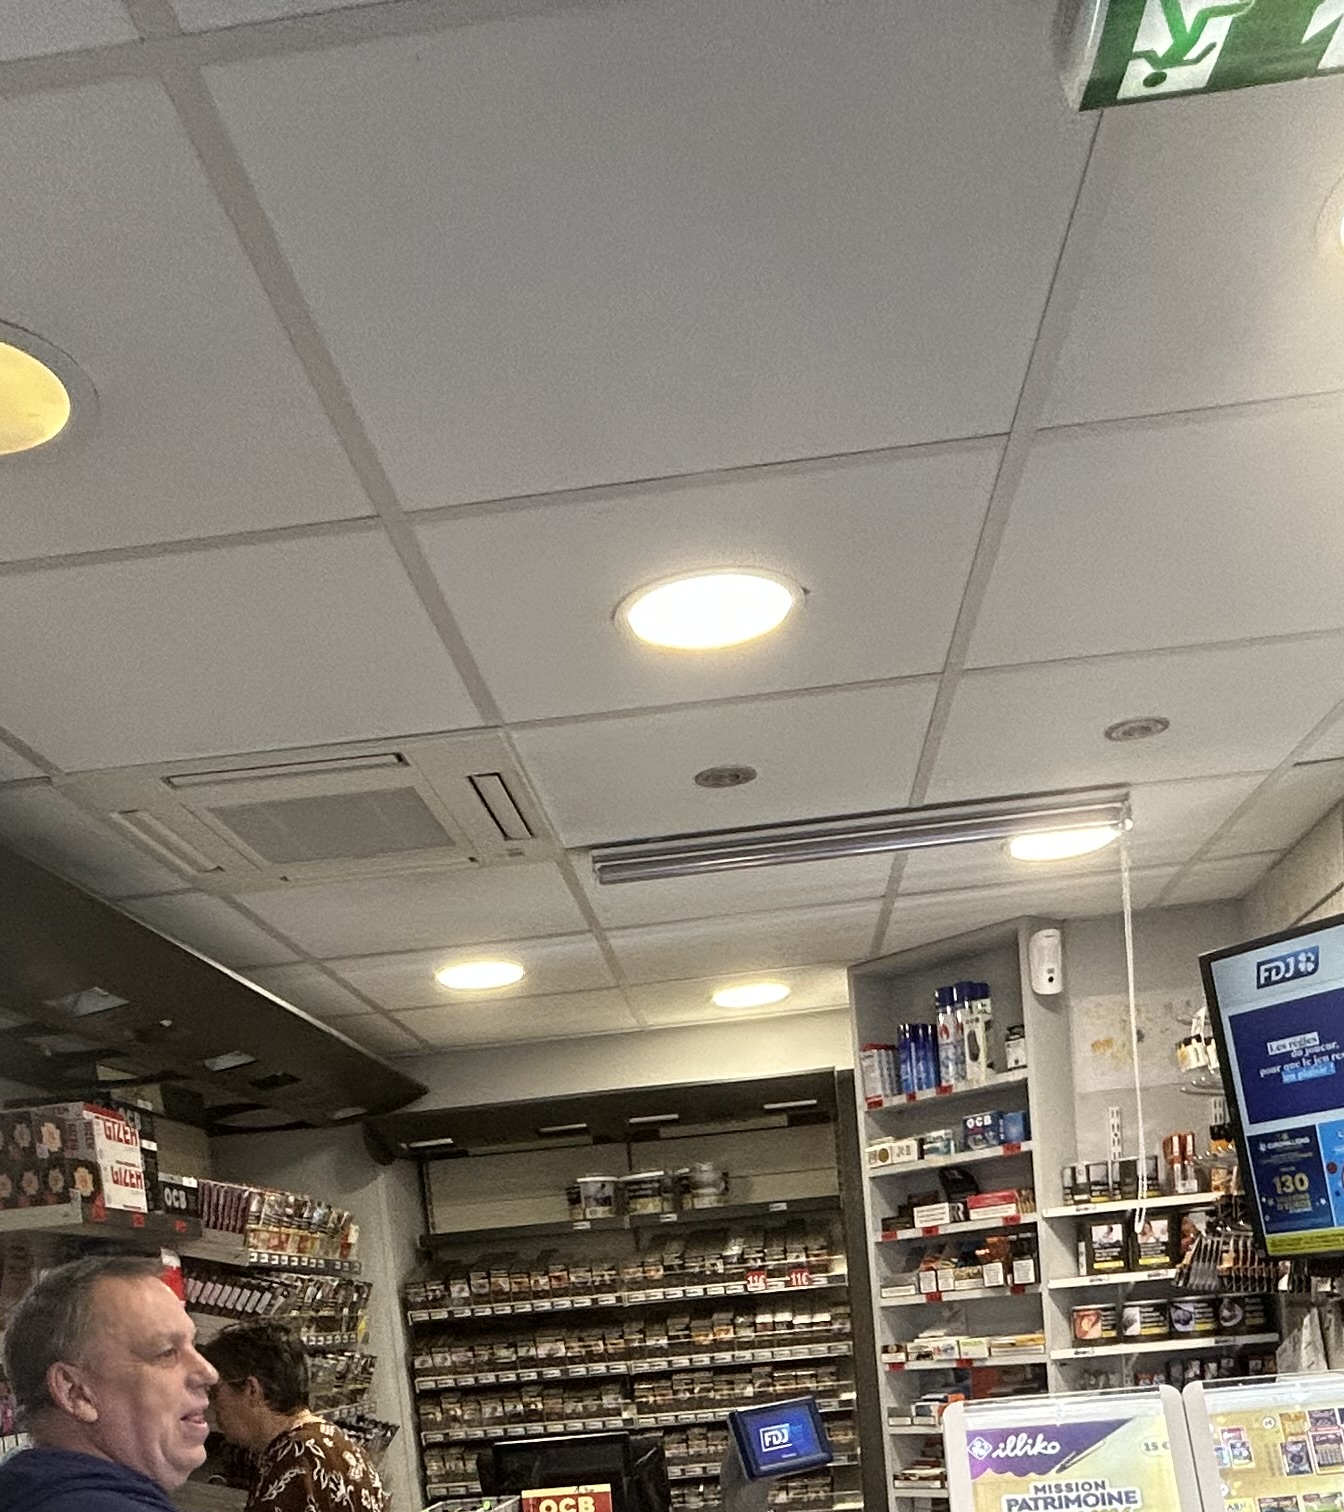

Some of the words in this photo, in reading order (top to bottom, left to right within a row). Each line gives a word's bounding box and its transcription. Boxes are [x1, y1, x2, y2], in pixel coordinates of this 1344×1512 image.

[1260, 957, 1295, 984] FDJ
[966, 1114, 992, 1129] OCB
[1272, 1172, 1309, 1194] 130
[164, 1187, 187, 1210] OCB
[763, 1427, 789, 1448] FDJ
[991, 1432, 1061, 1458] illiko
[1033, 1479, 1106, 1495] MISSION
[1006, 1490, 1138, 1512] PATRIMOINE
